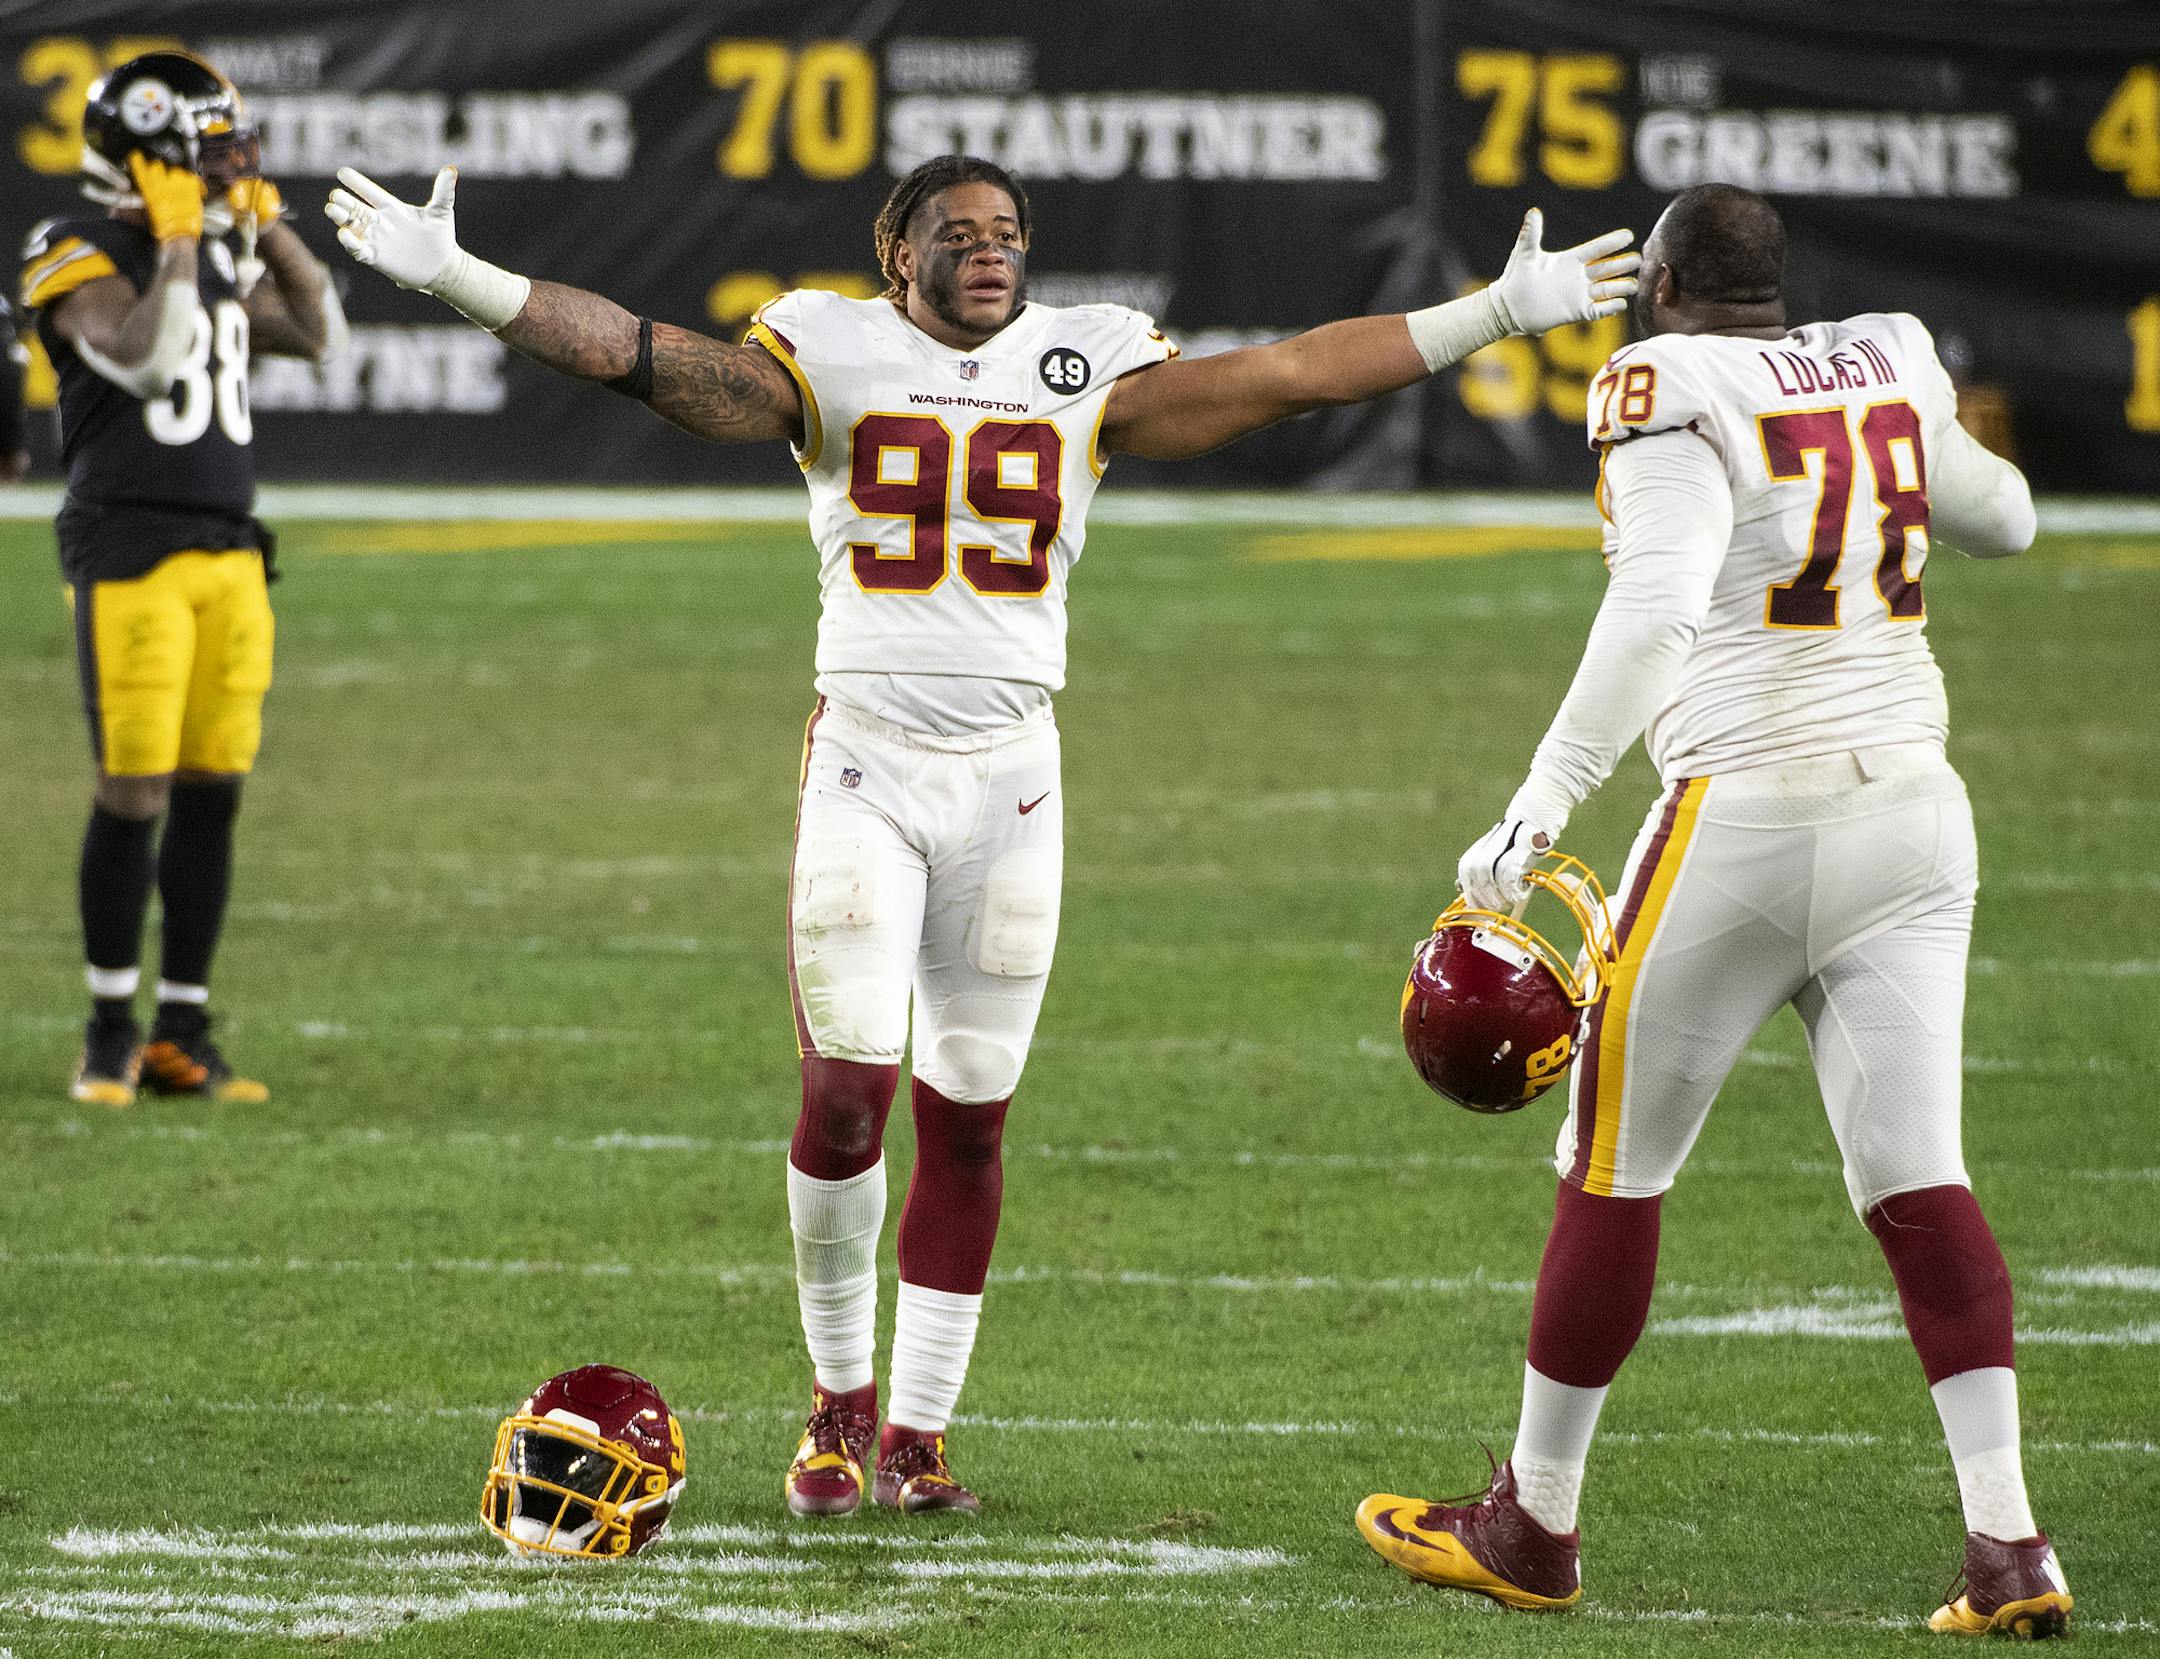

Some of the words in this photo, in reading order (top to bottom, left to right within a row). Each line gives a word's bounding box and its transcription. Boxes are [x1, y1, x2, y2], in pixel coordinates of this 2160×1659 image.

[245, 94, 634, 178] IESLING
[707, 40, 876, 178] 70
[886, 96, 1385, 180] STAUTNER
[1455, 52, 1626, 187] 75
[1634, 110, 2020, 197] GREENE
[908, 393, 1029, 413] WASHINGTON
[1044, 354, 1085, 387] 49
[1596, 362, 1657, 438] 78
[1759, 351, 1867, 396] LUCAS
[1851, 338, 1897, 385] III
[847, 411, 1065, 597] 99
[1755, 397, 1932, 630] 78
